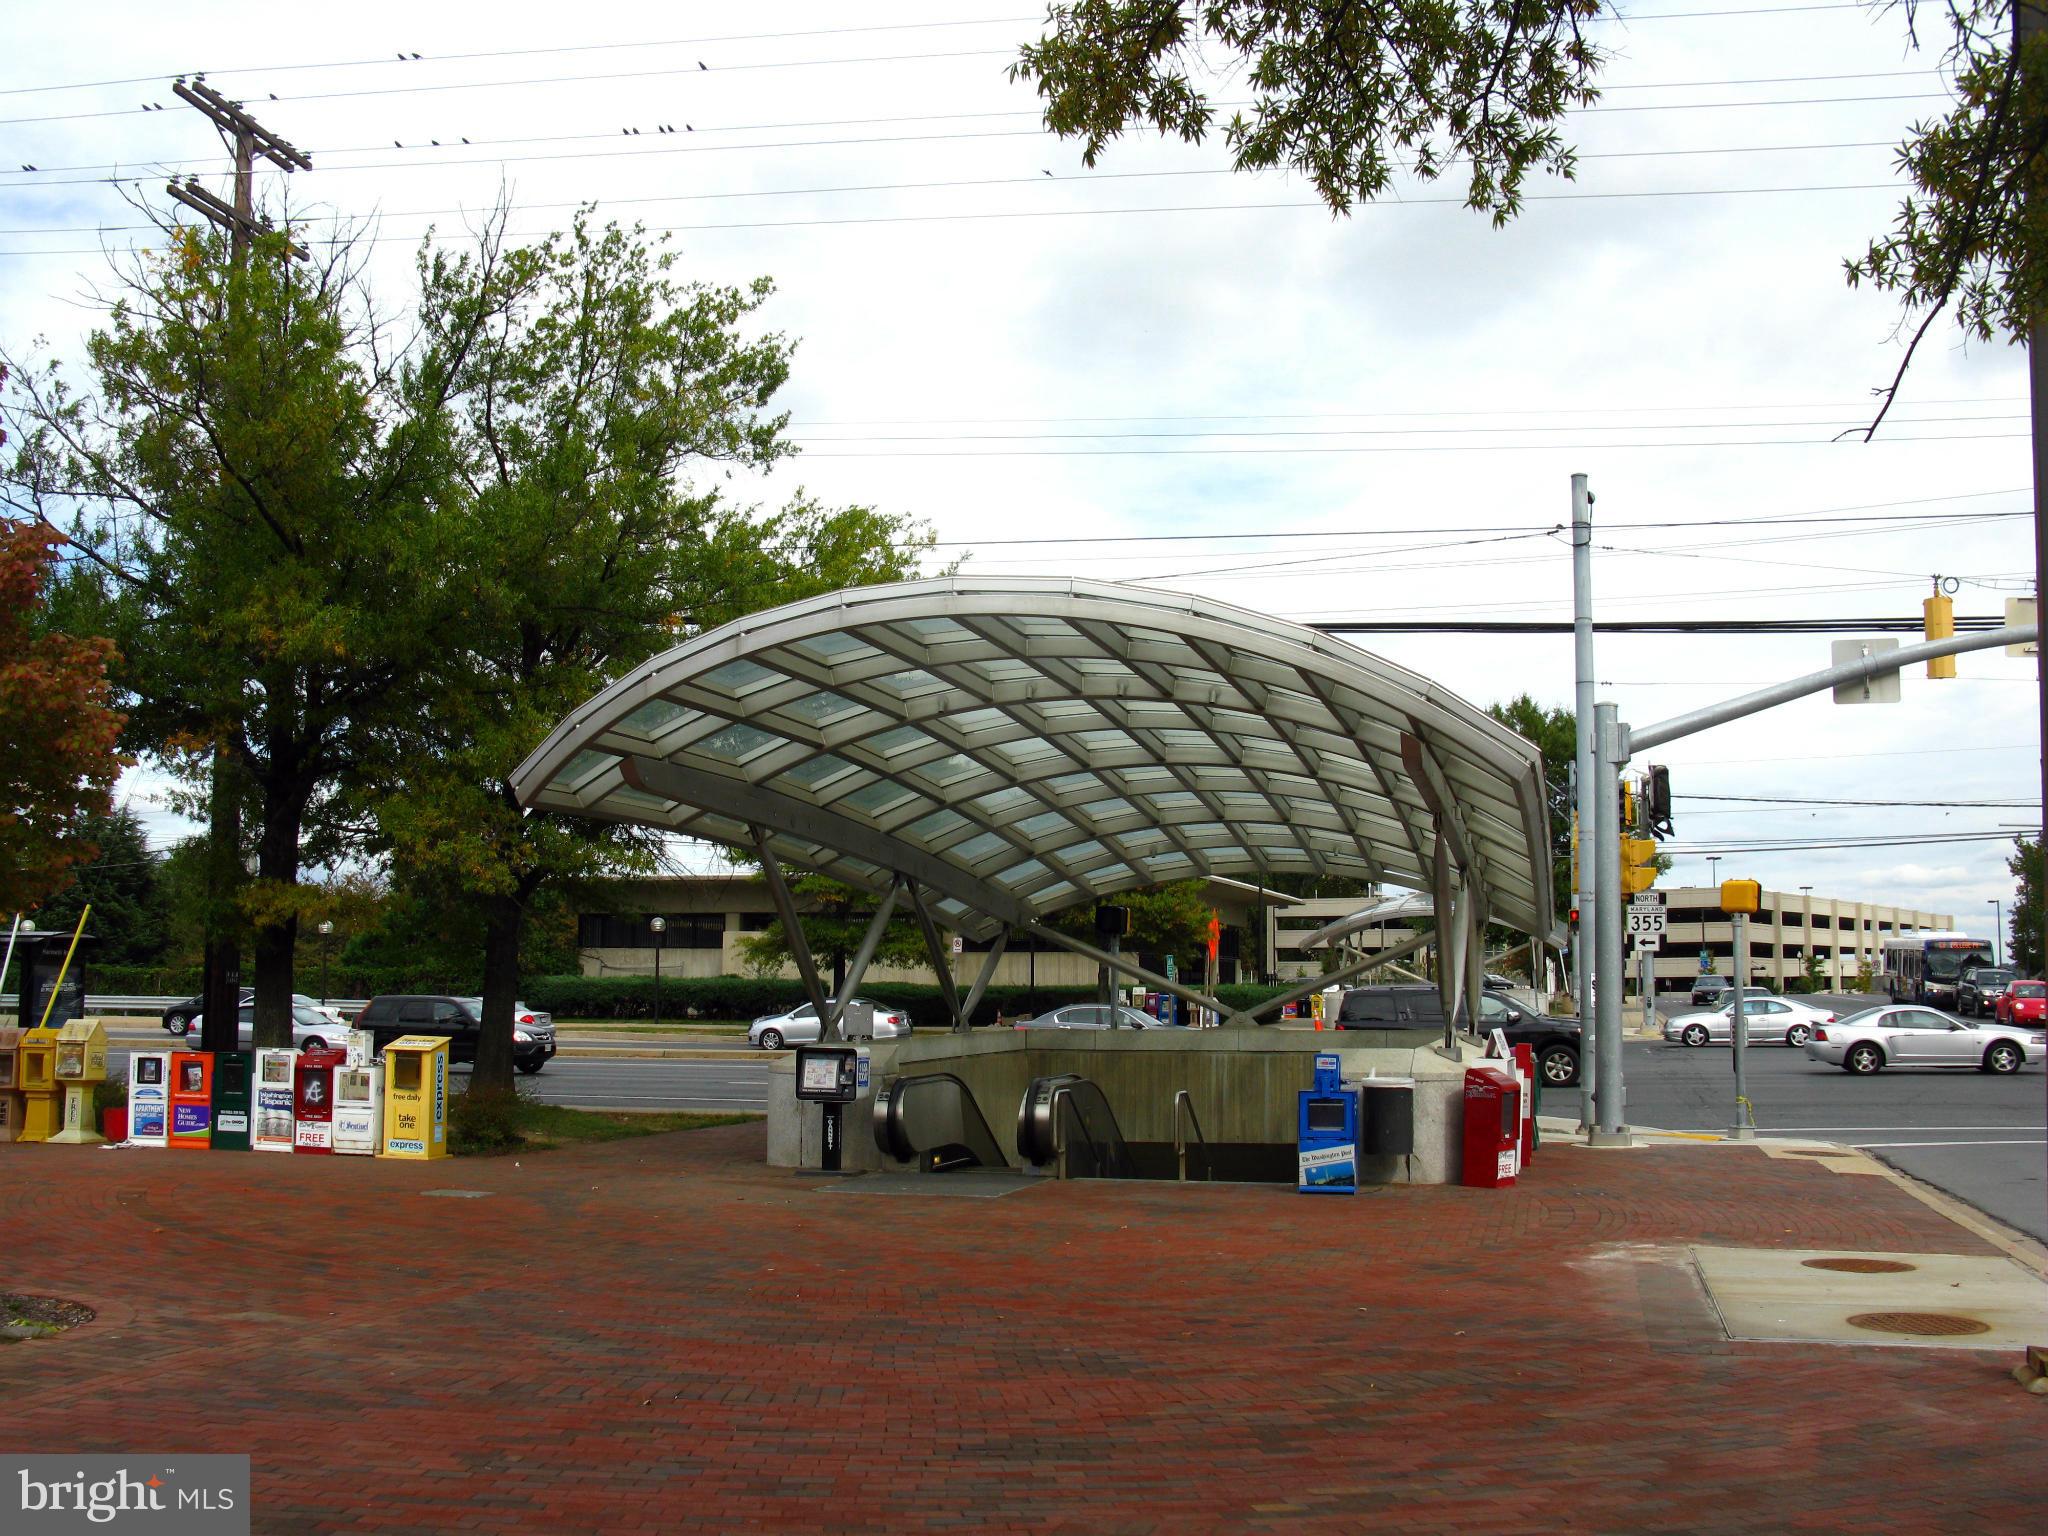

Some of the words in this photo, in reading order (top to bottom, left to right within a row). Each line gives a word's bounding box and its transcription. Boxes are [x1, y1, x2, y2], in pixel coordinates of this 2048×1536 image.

[1635, 894, 1658, 903] NORTH
[1631, 915, 1663, 931] 355
[436, 1054, 444, 1120] express
[260, 1092, 293, 1100] Washington
[393, 1093, 406, 1101] free
[406, 1094, 422, 1102] daily
[260, 1097, 293, 1106] Hispanic
[135, 1104, 164, 1113] APARTMENT
[398, 1114, 416, 1123] take
[299, 1132, 325, 1143] FREE
[389, 1140, 424, 1151] express
[1301, 1154, 1311, 1163] The
[1311, 1152, 1341, 1162] Washington
[1341, 1149, 1353, 1158] Post
[1498, 1163, 1512, 1174] FREE
